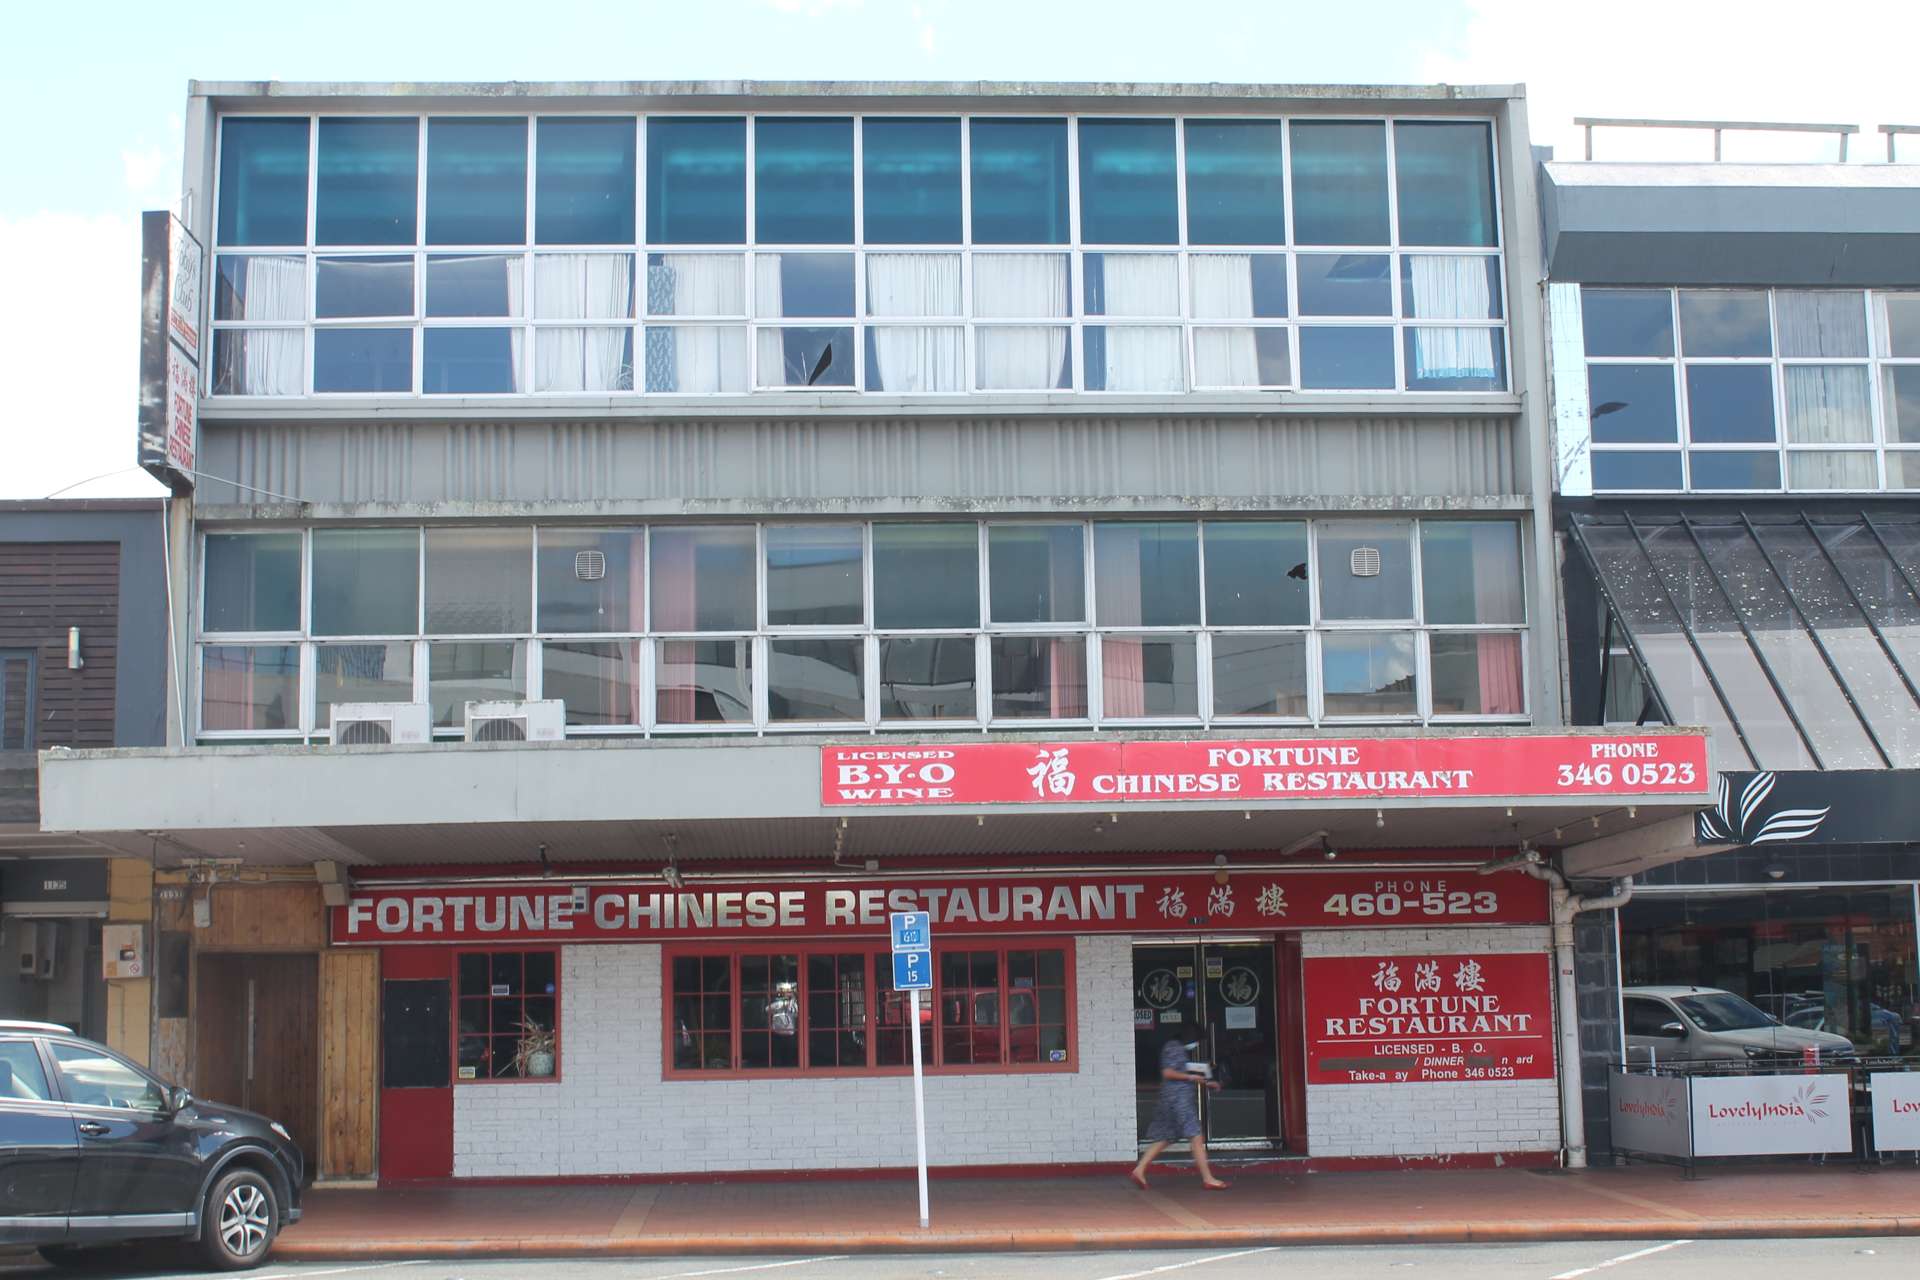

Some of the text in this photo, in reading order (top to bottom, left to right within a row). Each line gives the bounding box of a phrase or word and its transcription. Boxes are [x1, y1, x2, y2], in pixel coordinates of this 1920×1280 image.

[837, 751, 955, 761] LICENSED
[1207, 746, 1360, 768] FORTUNE
[1591, 743, 1659, 758] PHONE
[1026, 748, 1076, 797] 福
[1557, 762, 1696, 786] 346 0523
[1092, 769, 1473, 794] CHINESE RESTAURANT
[838, 788, 955, 799] WINE
[1375, 880, 1448, 892] PHONE
[347, 895, 575, 933] FORTUNE
[594, 890, 806, 930] CHINESE
[825, 885, 1144, 925] RESTAURANT
[1323, 891, 1498, 916] 460-523
[904, 915, 916, 930] P
[907, 953, 919, 969] P
[907, 970, 918, 982] 15
[1359, 996, 1500, 1016] FORTUNE
[1326, 1014, 1531, 1036] RESTAURANT
[1374, 1044, 1435, 1055] LICENSED
[1424, 1056, 1465, 1067] DINNER
[1421, 1068, 1458, 1079] Phone
[1464, 1068, 1485, 1078] 346
[1488, 1067, 1515, 1077] 0523
[1709, 1102, 1804, 1120] LovelyIndia
